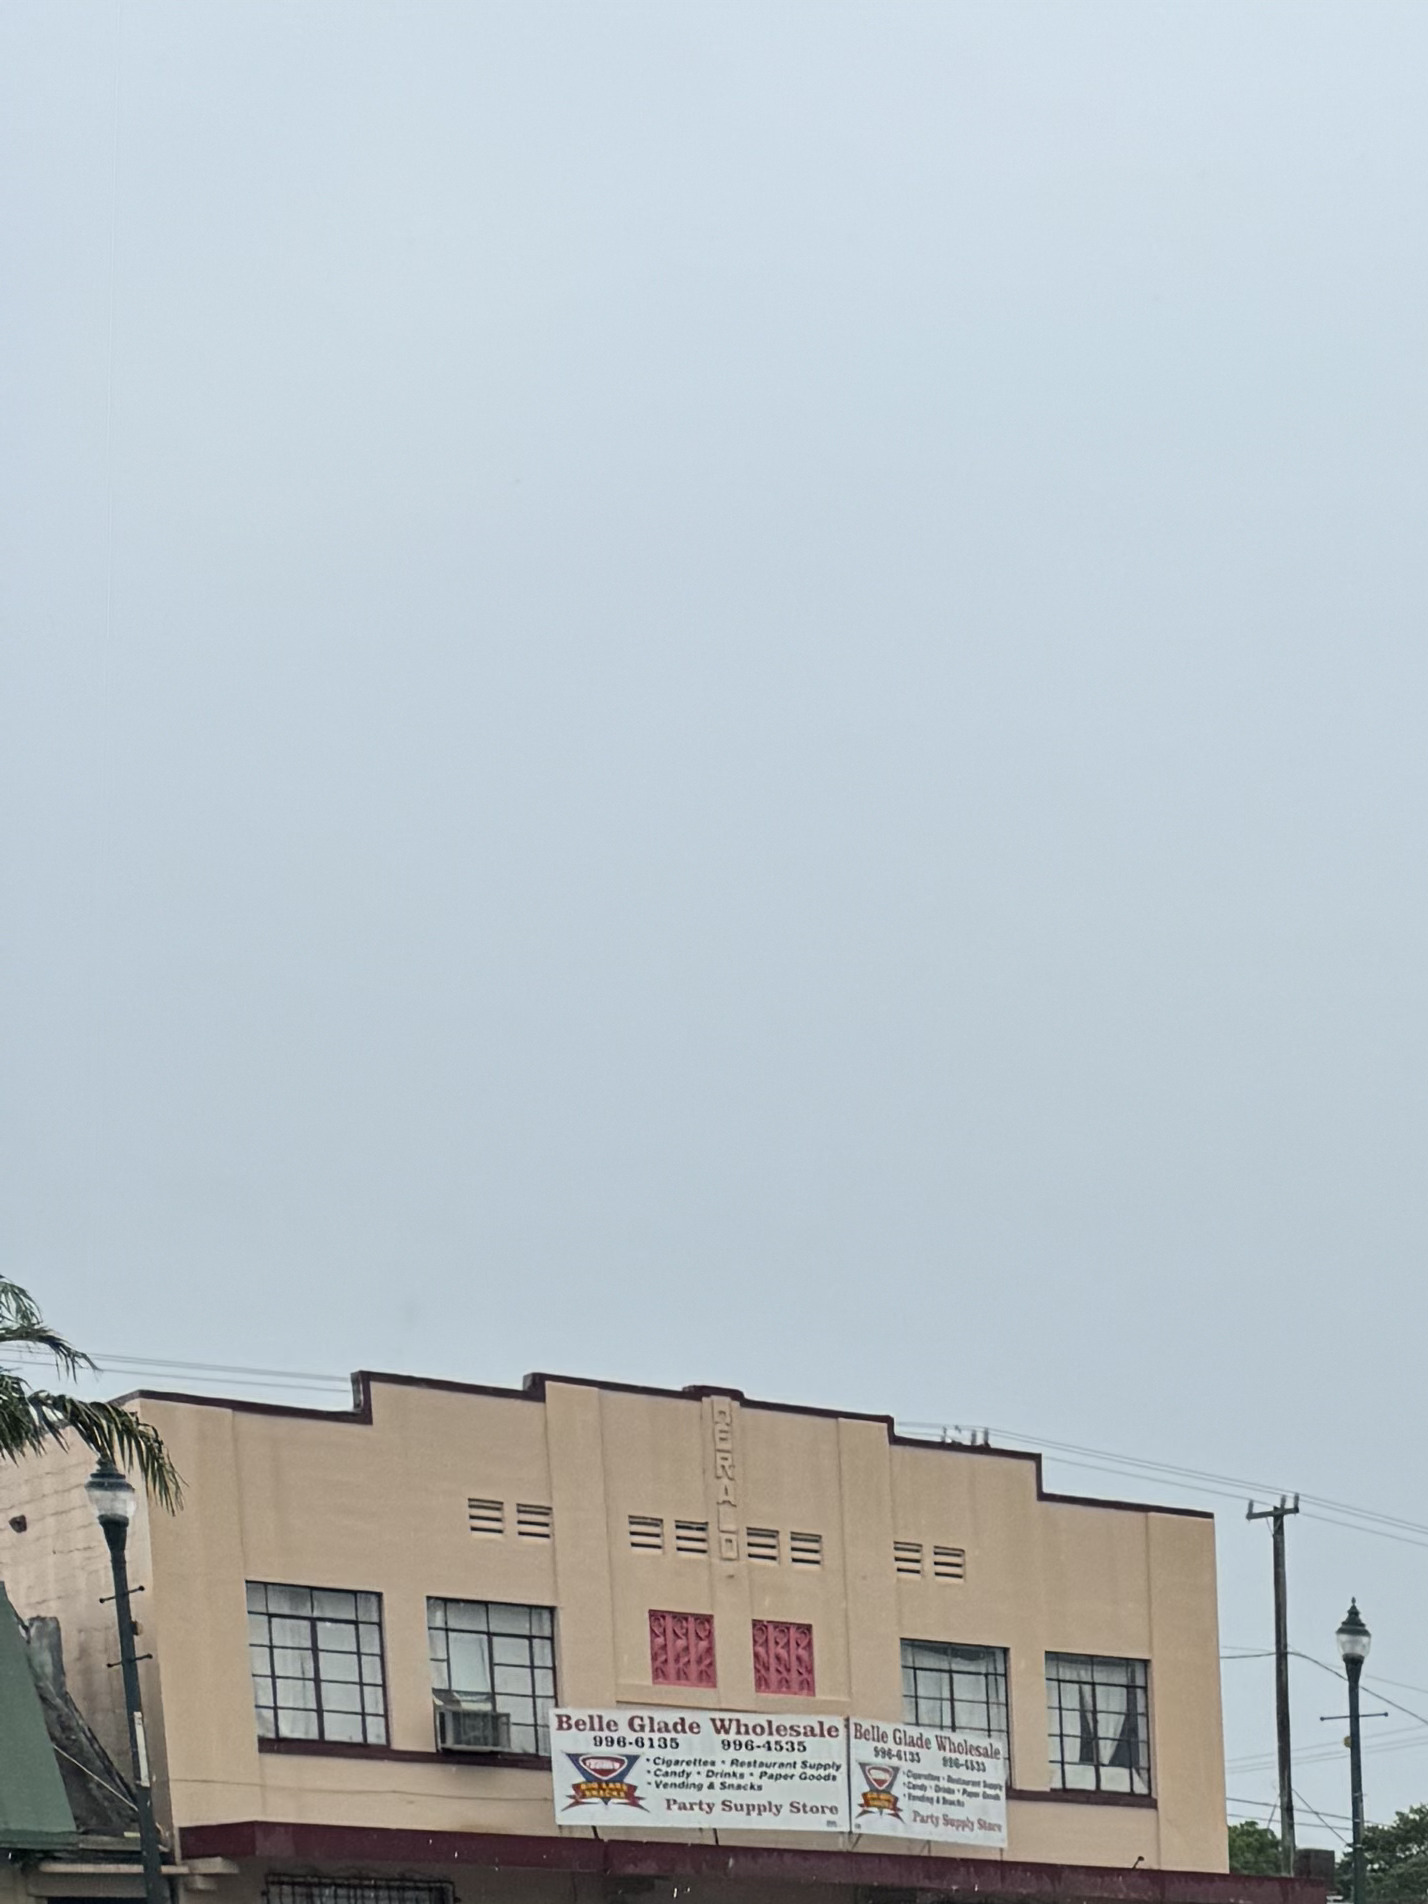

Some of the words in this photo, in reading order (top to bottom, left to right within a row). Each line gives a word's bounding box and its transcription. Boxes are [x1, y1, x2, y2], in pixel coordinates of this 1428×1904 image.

[555, 1714, 619, 1732] Belle
[628, 1715, 702, 1735] Glade
[709, 1717, 840, 1738] Wholesale
[593, 1735, 680, 1750] 996-6135
[721, 1739, 807, 1753] 996-4535
[853, 1722, 889, 1744] Belle
[892, 1728, 932, 1750] Glade
[935, 1734, 1002, 1760] Wholesale
[653, 1756, 716, 1768] Cigarettes
[730, 1758, 797, 1770] Restaurant
[800, 1760, 842, 1772] Supply
[653, 1769, 692, 1780] Candy
[705, 1769, 745, 1780] Drinks
[758, 1771, 795, 1782] Paper
[798, 1772, 837, 1782] Goods
[654, 1781, 703, 1792] Vending
[707, 1781, 715, 1791] &
[719, 1782, 763, 1792] Snacks
[665, 1799, 715, 1815] Party
[721, 1800, 783, 1817] Supply
[789, 1801, 839, 1815] Store
[912, 1810, 940, 1828] Party
[942, 1813, 975, 1832] Supply
